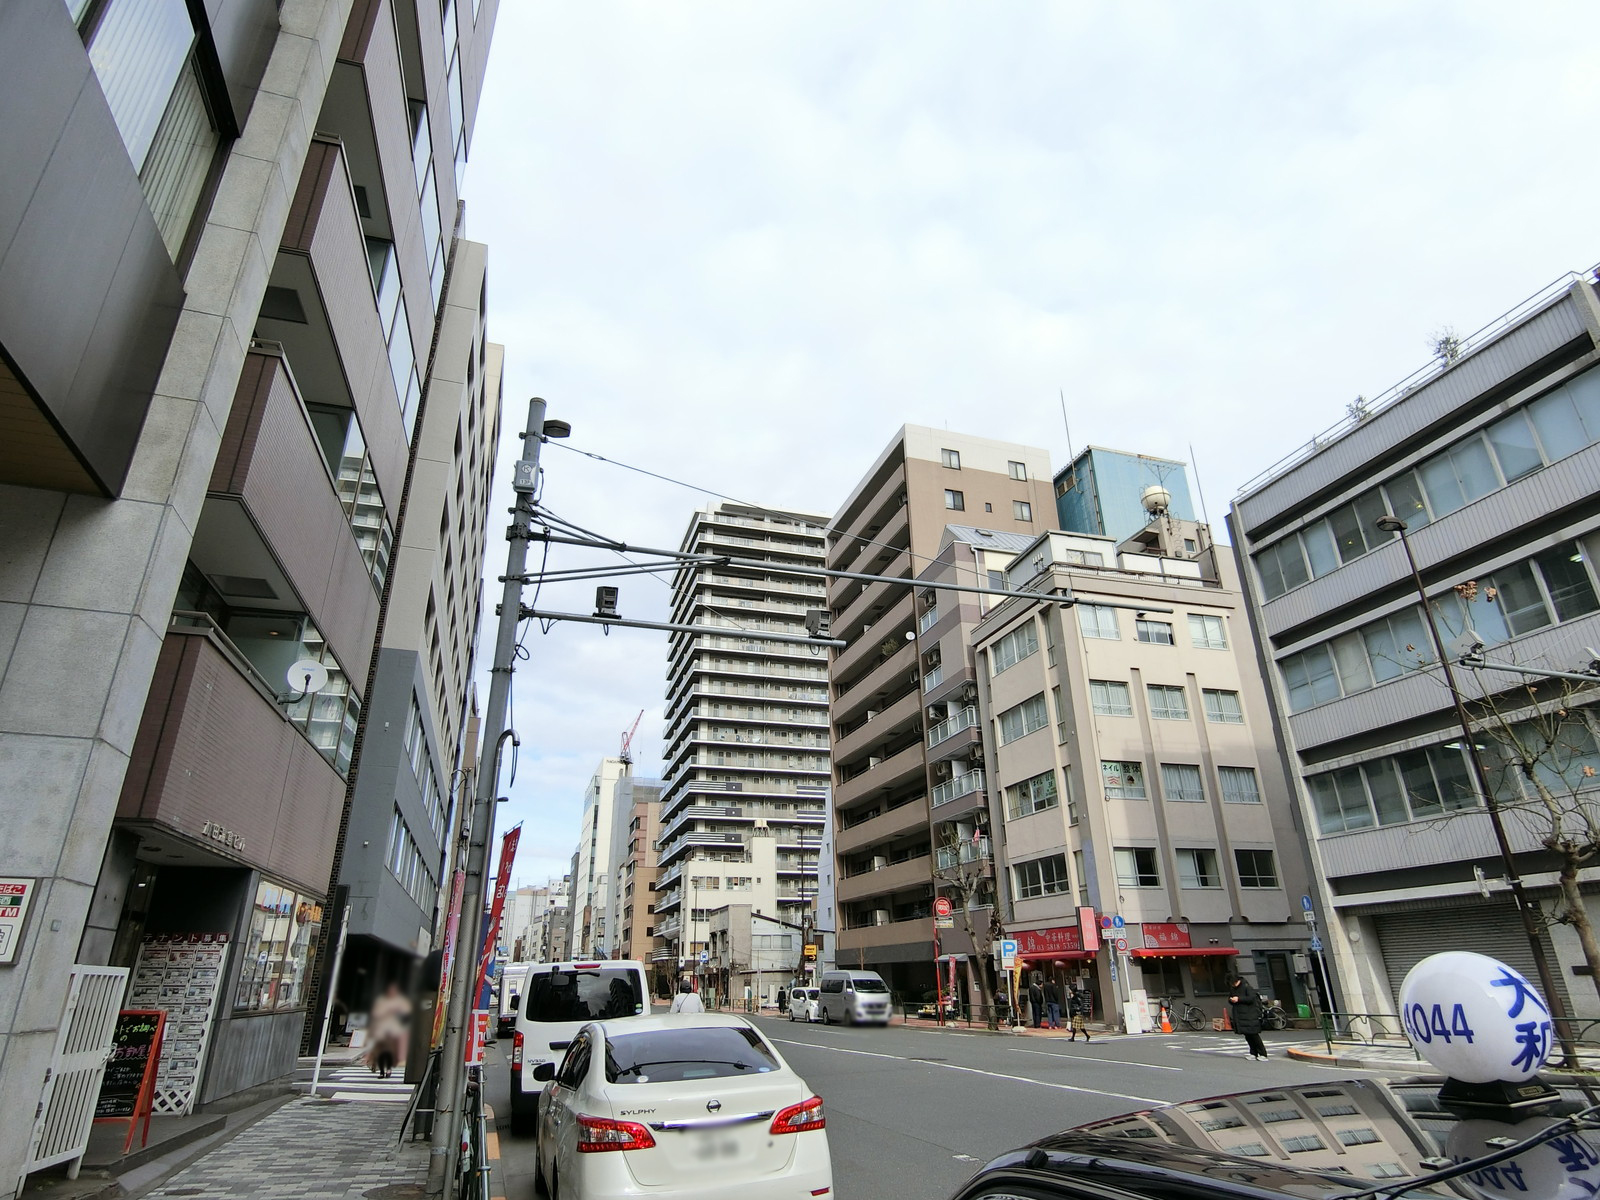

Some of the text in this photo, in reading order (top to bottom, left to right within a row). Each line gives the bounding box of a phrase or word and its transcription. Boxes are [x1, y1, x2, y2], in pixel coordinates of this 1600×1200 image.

[143, 933, 228, 942] テナント募集
[1490, 966, 1552, 1072] 大和
